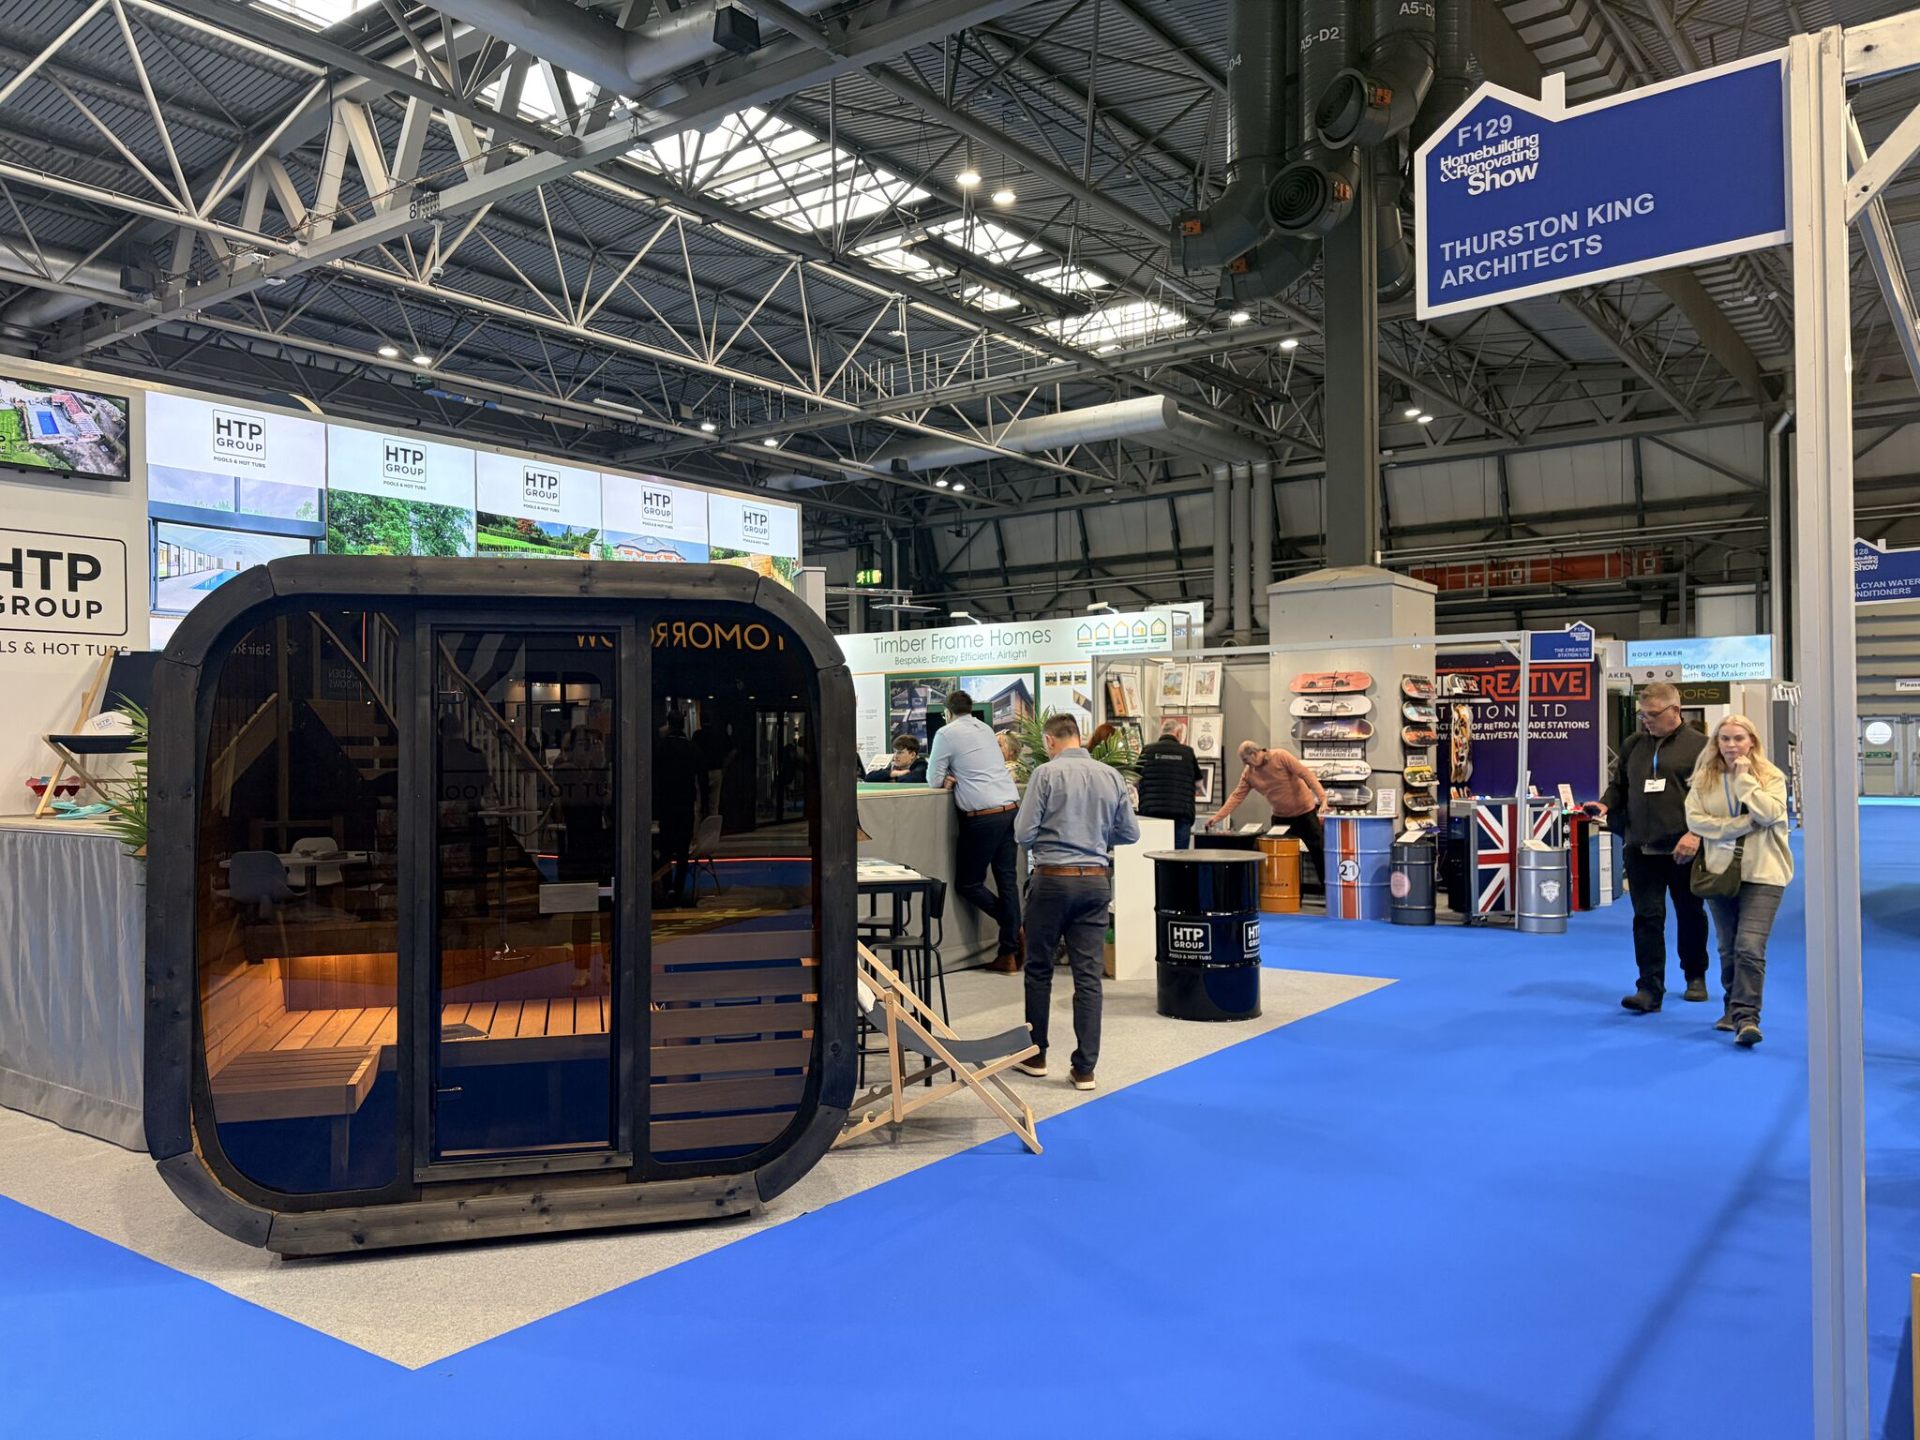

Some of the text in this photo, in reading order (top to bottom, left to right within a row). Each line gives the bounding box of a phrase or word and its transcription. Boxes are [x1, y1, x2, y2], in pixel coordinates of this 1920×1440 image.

[1457, 114, 1513, 148] F129
[1440, 132, 1539, 172] Homebuilding
[1466, 162, 1539, 196] Show
[1440, 192, 1655, 262] THURSTON KING
[1440, 233, 1602, 290] ARCHITECTS
[216, 416, 262, 440] HTP
[216, 437, 263, 452] GROUP
[386, 445, 424, 465] HTP
[385, 463, 424, 476] GROUP
[525, 471, 558, 490] HTP
[525, 488, 558, 500] GROUP
[643, 491, 671, 508] HTP
[643, 506, 671, 517] GROUP
[743, 510, 768, 526] HTP
[743, 525, 768, 535] GROUP
[0, 595, 103, 620] ROUP
[23, 641, 36, 654] &
[43, 642, 80, 655] HOT
[873, 628, 1052, 654] Timber Frame Homes
[894, 649, 1028, 667] Bespoke, Energy Efficient, Airtight
[1683, 660, 1765, 672] Open up your home
[1720, 669, 1747, 678] Maker
[1749, 669, 1765, 677] and
[1530, 703, 1567, 718] LTD
[1483, 721, 1511, 732] RETRO
[1547, 720, 1590, 730] STATIONS
[1340, 864, 1356, 876] 21
[1173, 926, 1204, 941] HTP
[1173, 940, 1205, 949] GROUP
